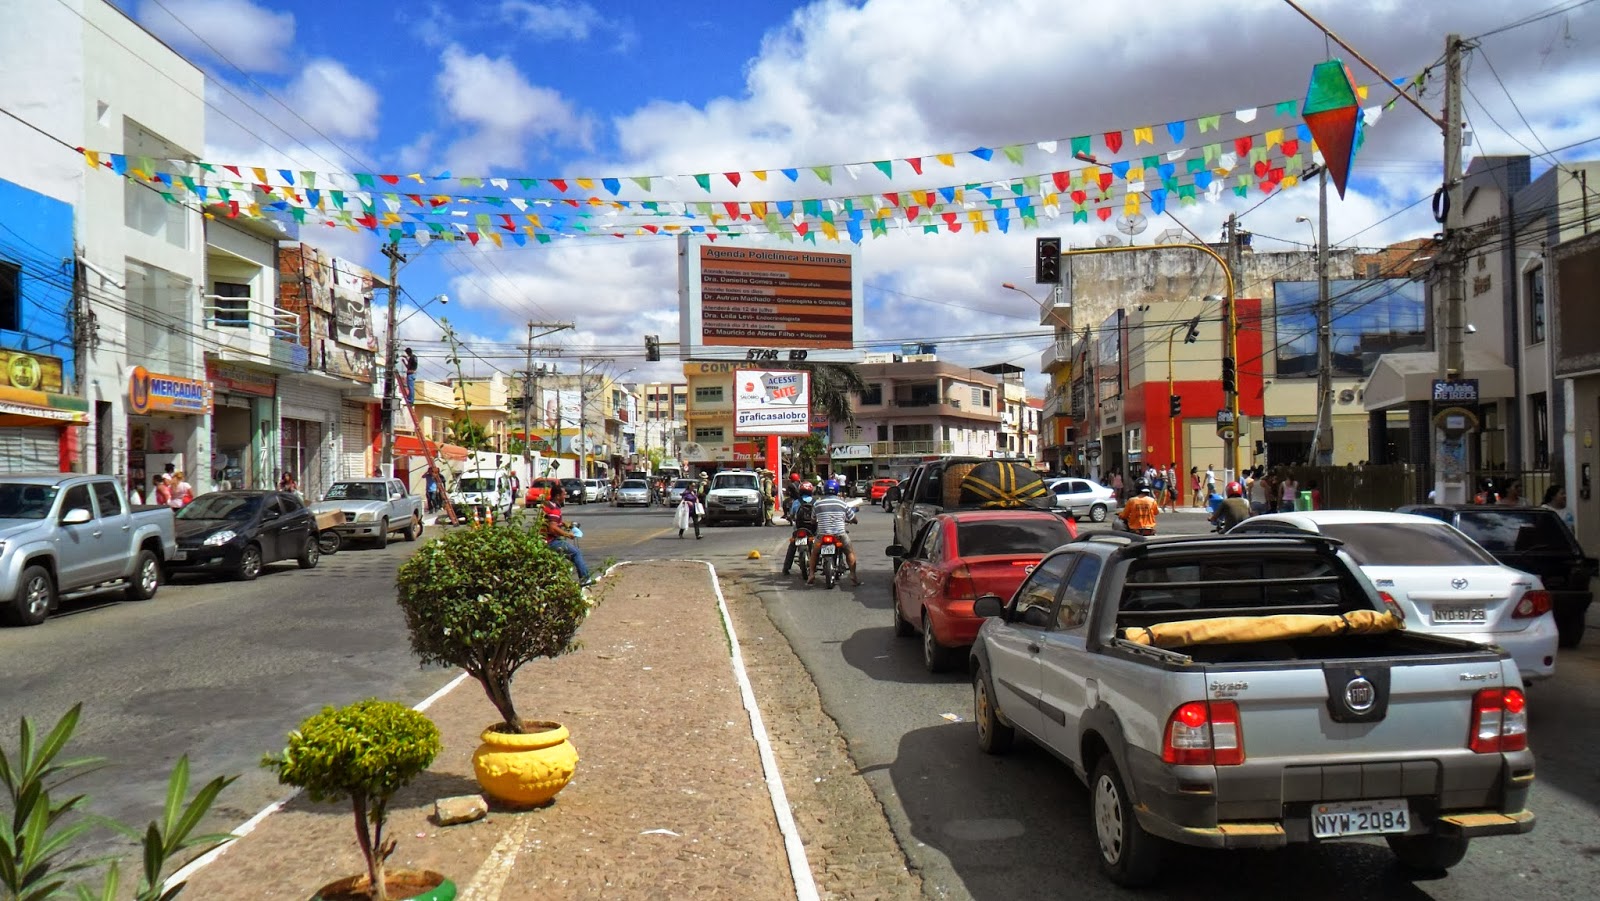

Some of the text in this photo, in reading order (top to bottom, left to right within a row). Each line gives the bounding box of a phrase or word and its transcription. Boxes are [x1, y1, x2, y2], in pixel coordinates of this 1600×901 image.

[706, 249, 745, 258] Agenda
[802, 254, 847, 264] Humanas
[747, 350, 778, 360] STAR
[768, 376, 796, 384] ACESSE
[150, 378, 203, 400] MERCADÃO
[772, 386, 796, 400] SITE
[1434, 392, 1448, 400] DE
[740, 412, 806, 423] graficasalobro
[1352, 688, 1368, 702] FIAT
